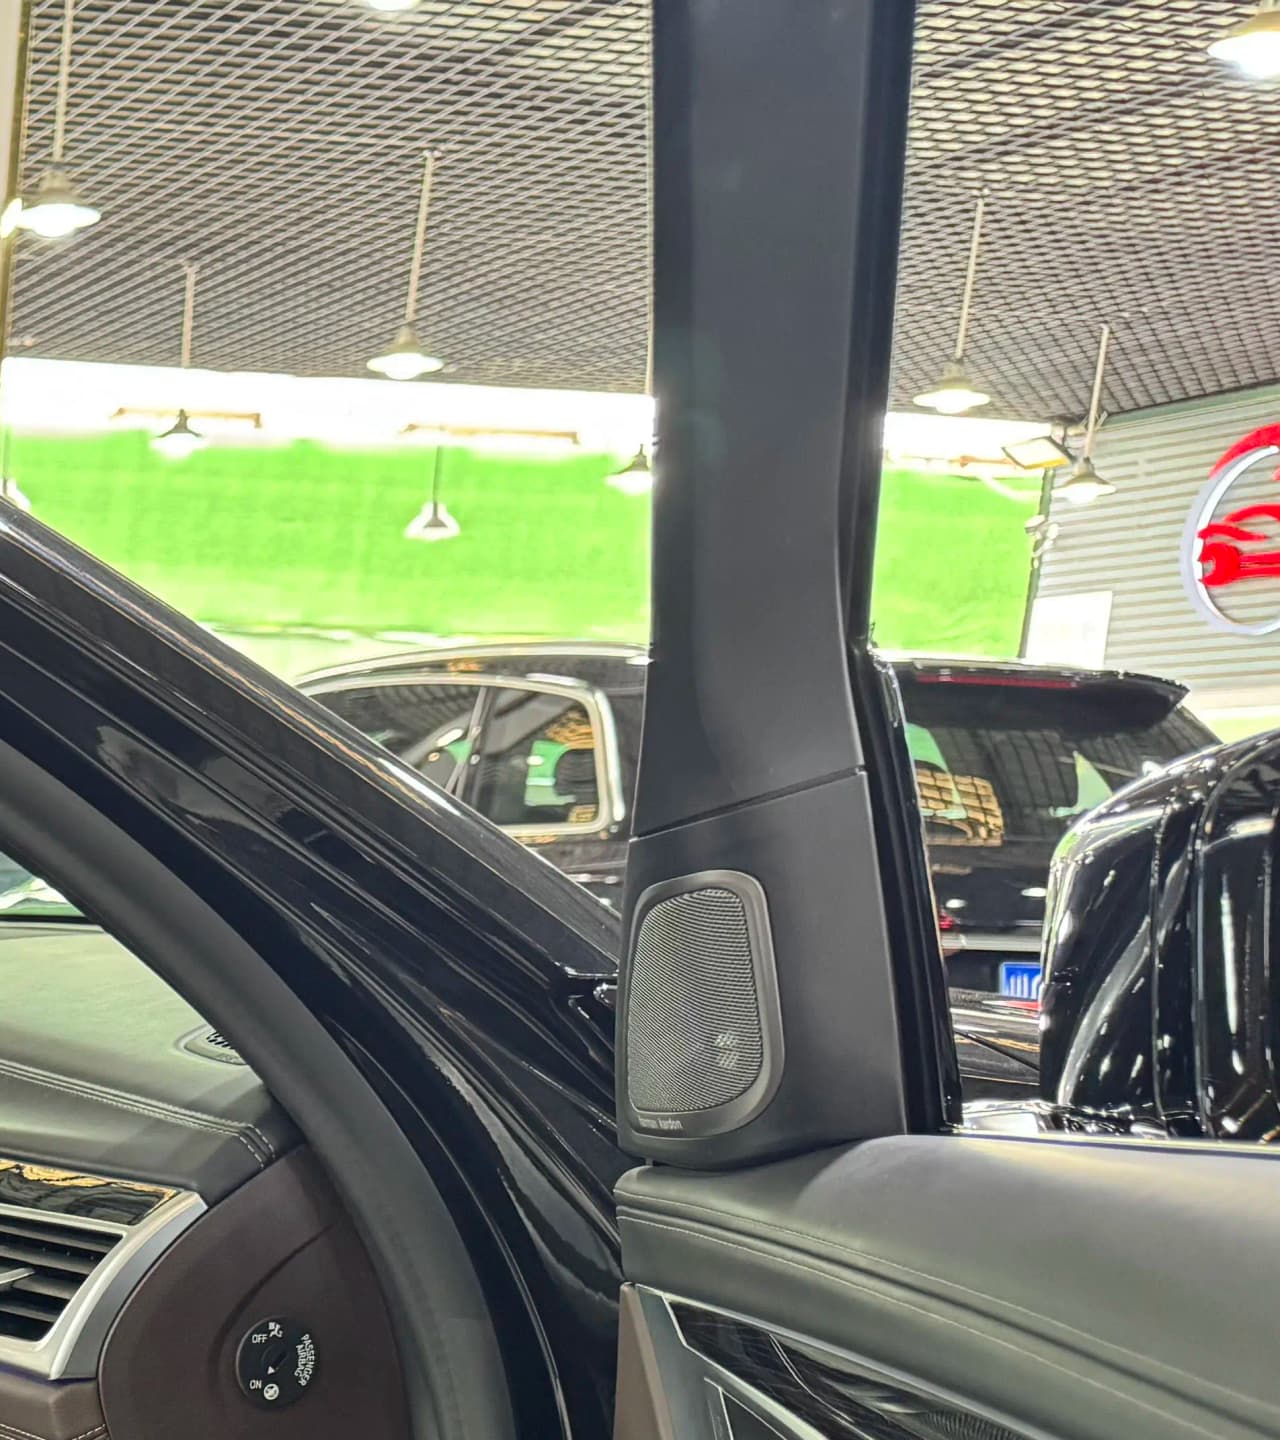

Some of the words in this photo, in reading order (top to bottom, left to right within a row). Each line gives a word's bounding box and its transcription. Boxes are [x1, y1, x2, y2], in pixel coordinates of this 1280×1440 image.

[252, 1334, 268, 1343] OFF
[298, 1334, 315, 1386] PASSENGER
[249, 1379, 262, 1389] ON
